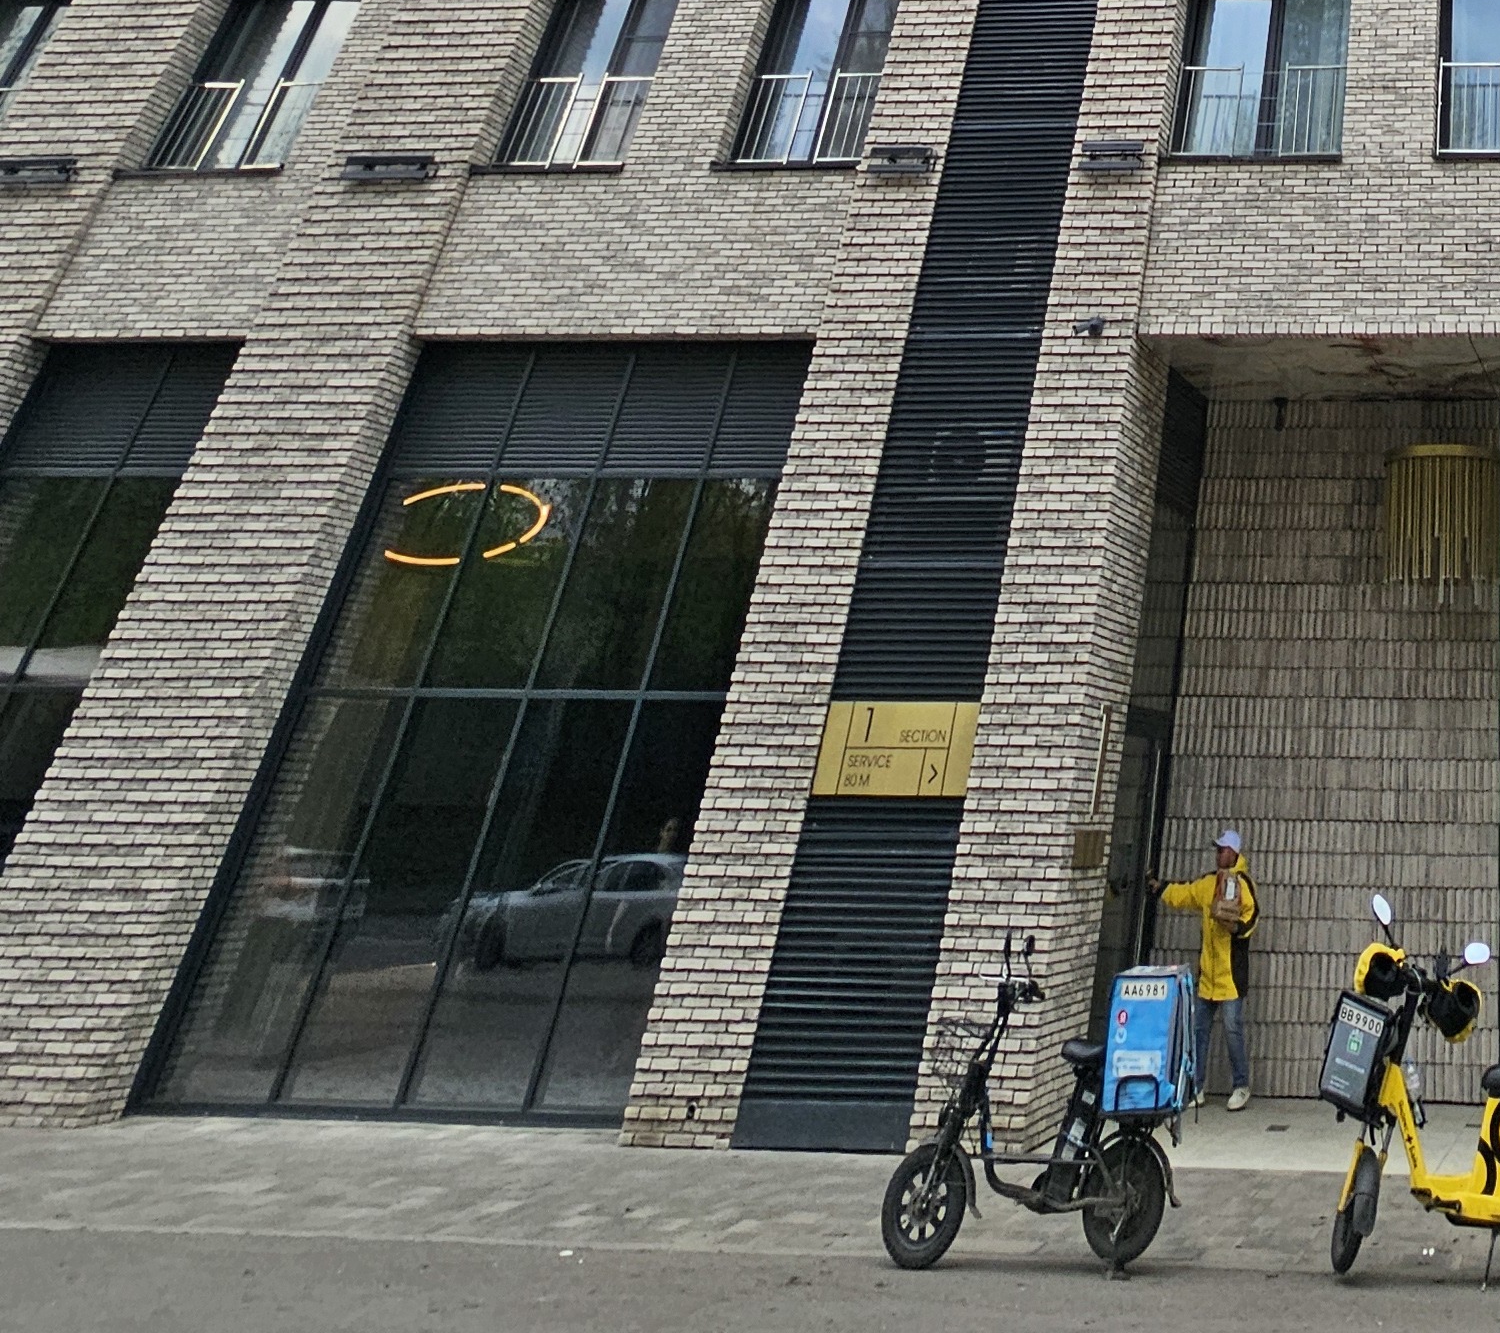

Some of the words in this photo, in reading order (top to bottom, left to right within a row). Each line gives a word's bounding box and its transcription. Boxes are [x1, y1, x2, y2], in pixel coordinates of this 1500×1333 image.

[864, 707, 875, 743] 1
[900, 729, 946, 743] SECTION
[847, 754, 893, 768] SERVICE
